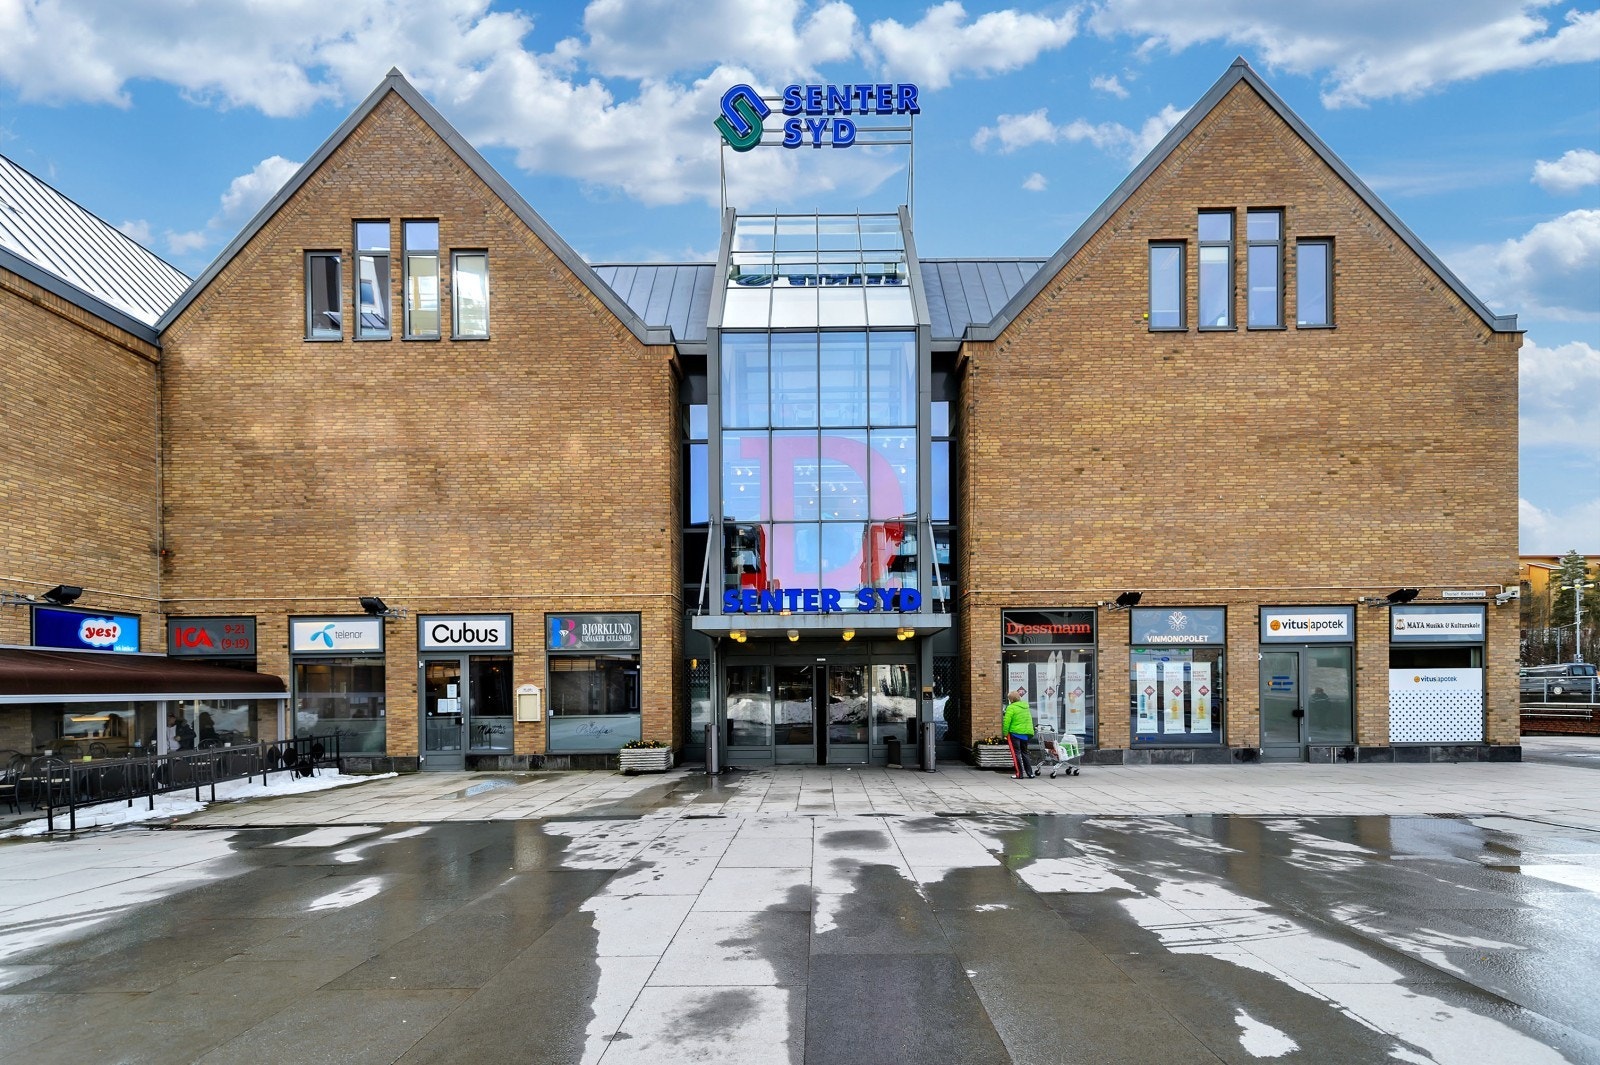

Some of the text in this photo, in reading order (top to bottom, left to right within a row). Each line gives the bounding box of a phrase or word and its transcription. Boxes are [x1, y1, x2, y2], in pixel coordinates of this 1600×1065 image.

[782, 83, 920, 115] SENTER
[782, 117, 856, 149] SYD
[723, 587, 922, 613] SENTER SYD
[224, 624, 245, 634] 9-21
[582, 623, 632, 635] BJØRKLUND
[1006, 622, 1091, 635] Dressmann
[1407, 621, 1425, 629] MAYA
[85, 626, 117, 638] yes!
[175, 627, 213, 648] ICA
[334, 629, 363, 641] telenor
[432, 622, 499, 644] Cubus
[221, 638, 250, 650] (9-19)
[1147, 634, 1208, 643] VINMONOPOLET
